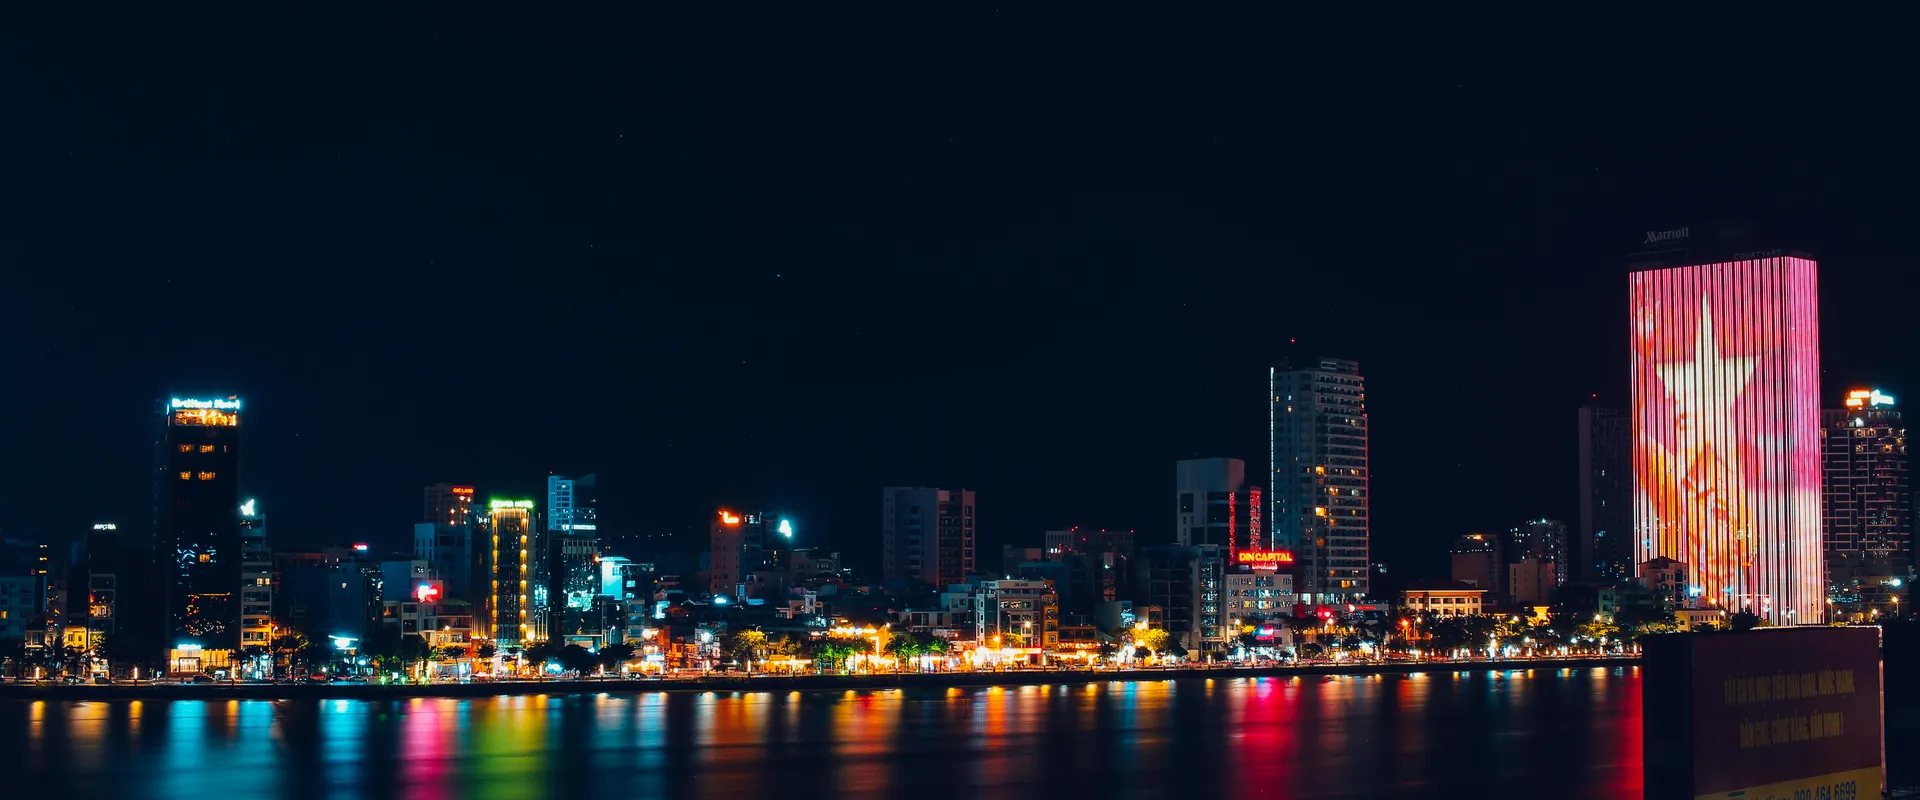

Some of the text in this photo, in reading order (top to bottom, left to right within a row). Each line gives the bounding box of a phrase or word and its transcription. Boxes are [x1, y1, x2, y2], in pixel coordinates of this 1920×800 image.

[1644, 226, 1689, 244] Marriott
[1733, 249, 1782, 260] COURTYARD
[1255, 552, 1293, 561] CAPITAL
[1834, 781, 1857, 800] 6699
